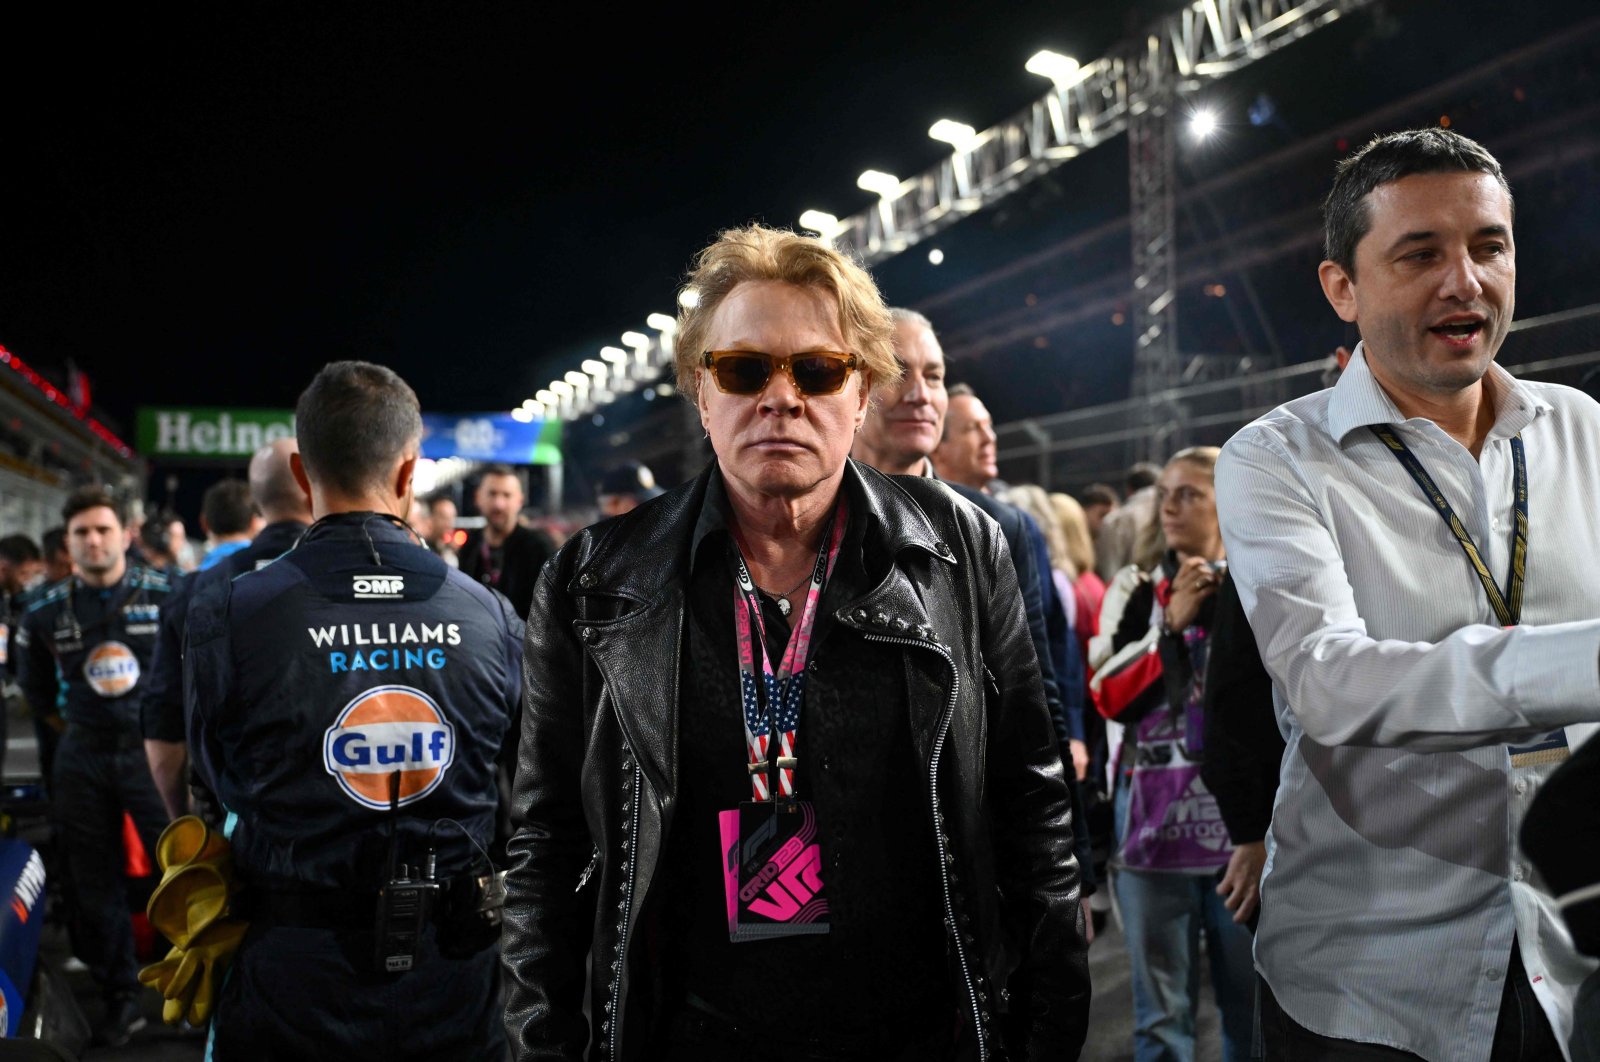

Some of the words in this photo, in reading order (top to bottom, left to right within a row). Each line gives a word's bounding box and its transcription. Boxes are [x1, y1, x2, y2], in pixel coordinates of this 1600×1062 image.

[156, 411, 297, 454] Heine
[353, 580, 404, 594] OMP
[308, 622, 462, 648] WILLIAMS
[330, 648, 447, 673] RACING
[332, 731, 446, 766] Gulf
[1138, 821, 1227, 841] PHOTOG
[739, 861, 779, 902] GRID
